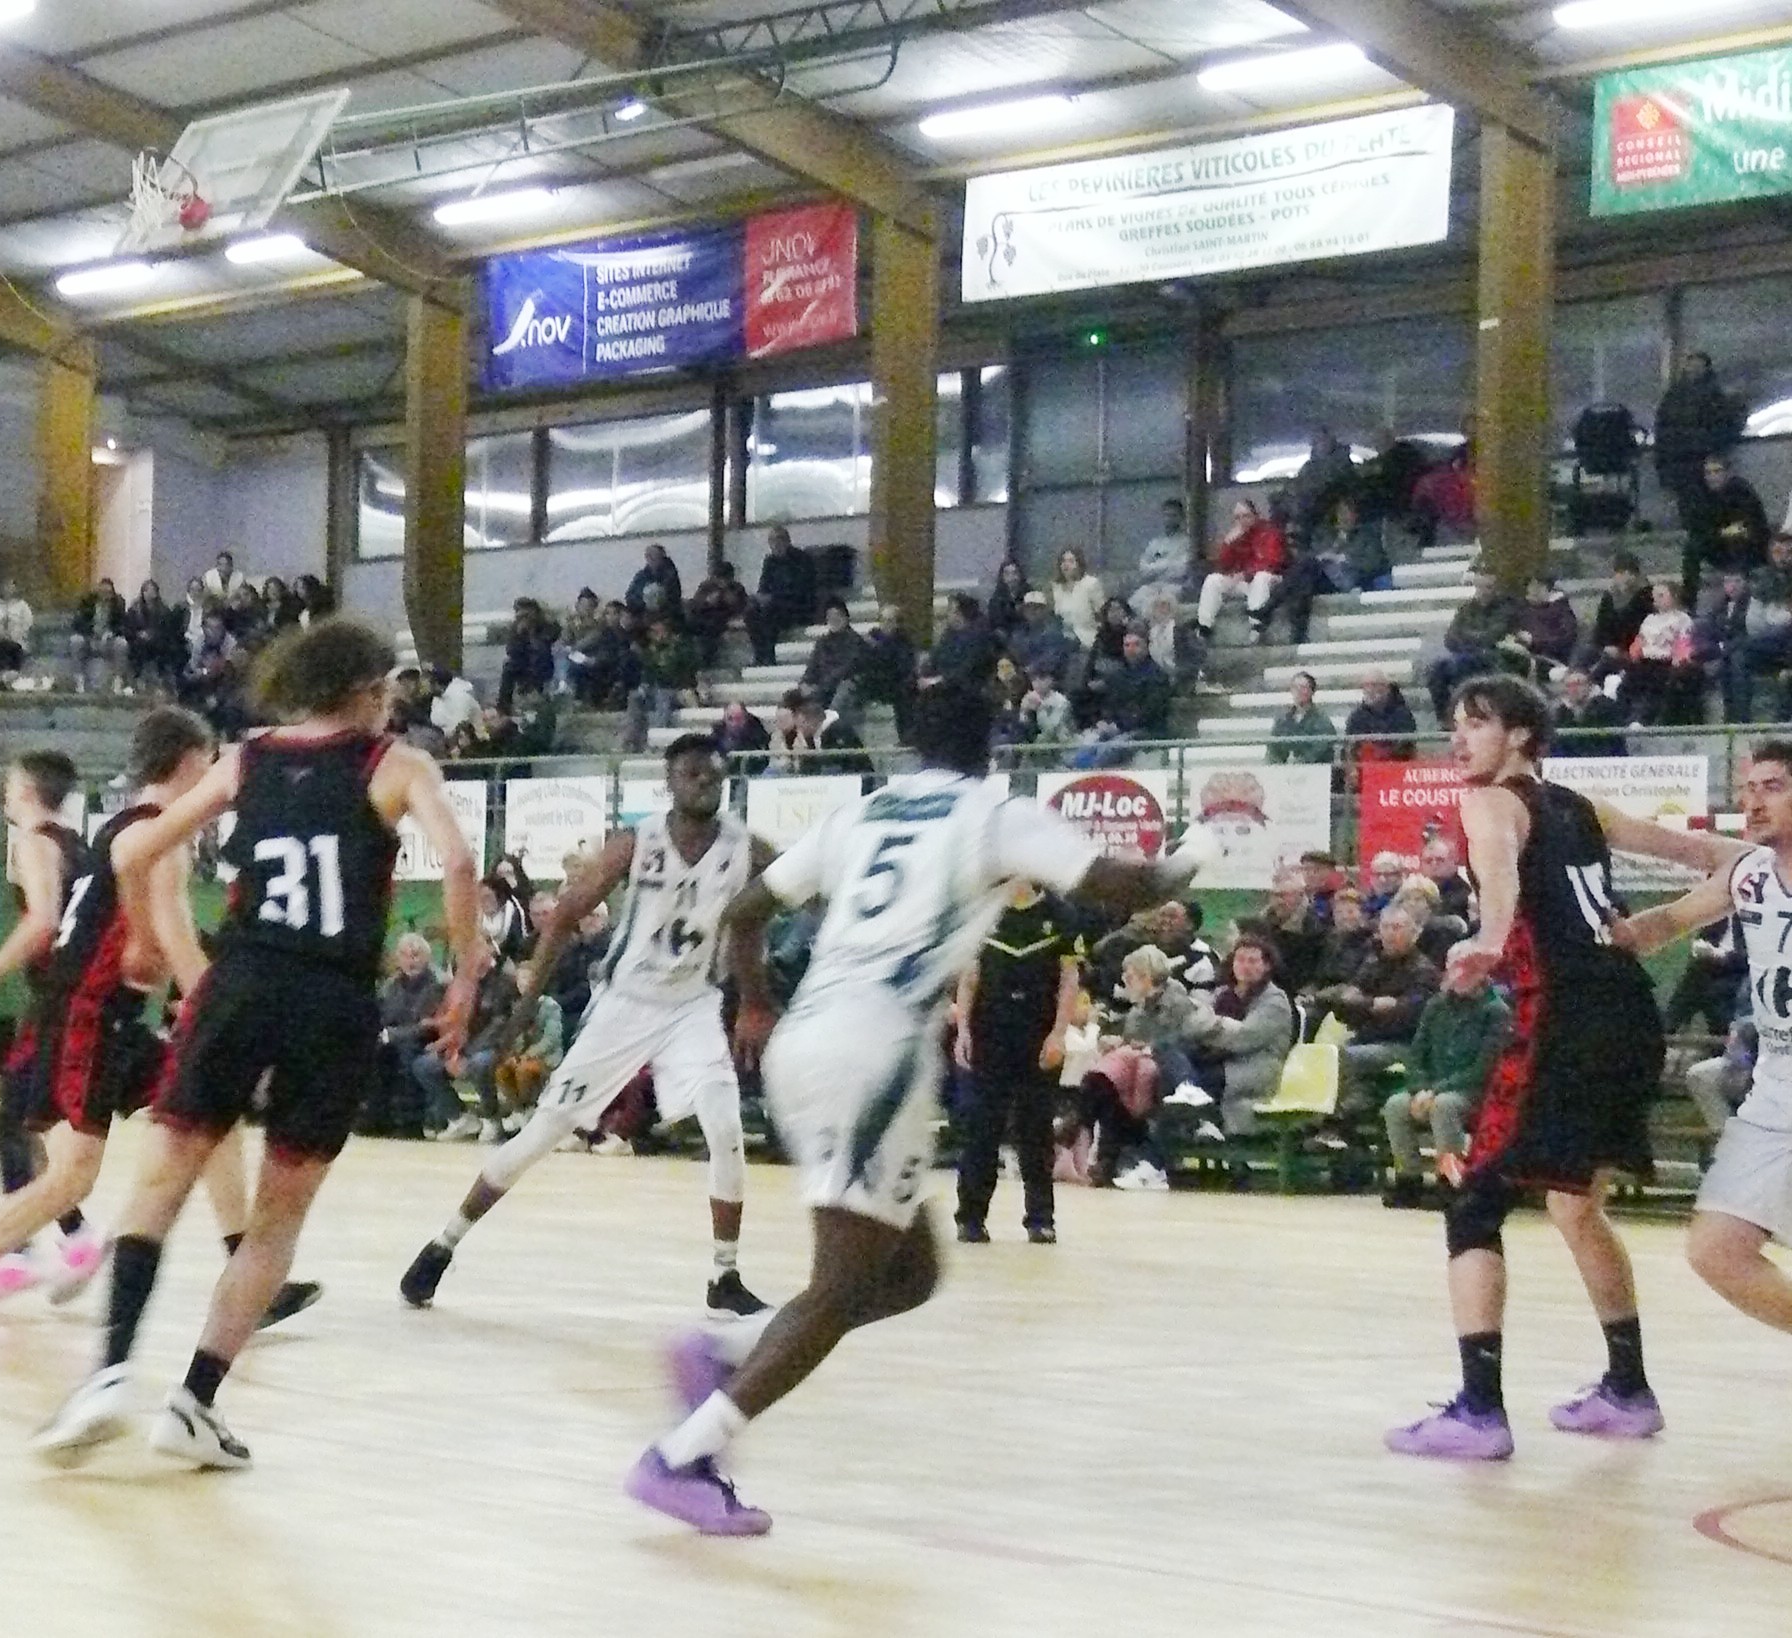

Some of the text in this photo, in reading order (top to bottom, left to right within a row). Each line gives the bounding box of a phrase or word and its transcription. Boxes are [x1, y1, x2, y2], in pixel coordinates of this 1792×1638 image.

[1617, 134, 1681, 153] CONSEIL
[1191, 145, 1296, 179] VITICOLES
[1733, 146, 1785, 174] une
[1097, 213, 1116, 229] DE
[1120, 204, 1172, 225] VIGNES
[1274, 183, 1315, 204] TOUS
[1119, 220, 1182, 242] GREFFES
[1187, 211, 1255, 235] SOUDÉES
[1271, 204, 1310, 222] POTS
[596, 254, 693, 285] SITES INTERNET
[596, 280, 678, 312] E-COMMERCE
[596, 308, 656, 337] CREATION
[657, 297, 731, 328] GRAPHIQUE
[595, 334, 665, 363] PACKAGING
[1403, 767, 1465, 783] AUBERG
[1550, 761, 1699, 780] ÉLECTRICITÉ GÉNÉRALE
[1061, 791, 1148, 819] MJ-Loc
[1379, 788, 1400, 807] LE
[251, 833, 345, 938] 31
[858, 834, 916, 919] 5
[558, 1077, 588, 1105] 11
